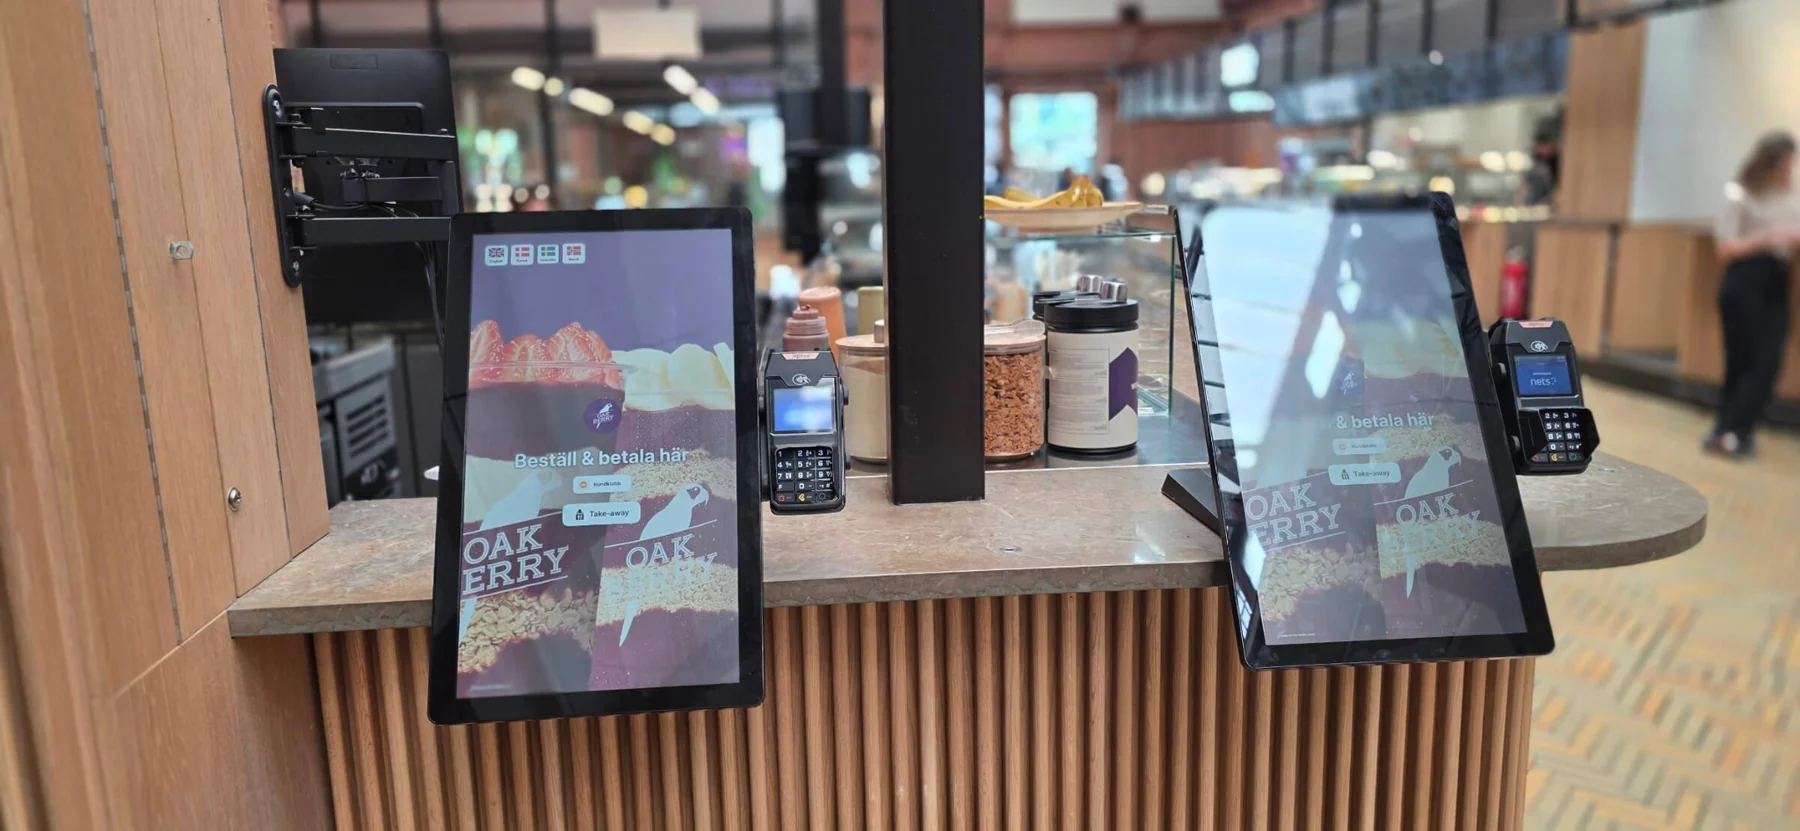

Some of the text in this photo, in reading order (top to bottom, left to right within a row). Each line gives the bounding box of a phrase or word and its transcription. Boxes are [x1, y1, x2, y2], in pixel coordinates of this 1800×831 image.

[1530, 378, 1551, 386] nets
[1336, 412, 1434, 429] & betala här
[515, 447, 688, 468] Beställ & betala här
[1246, 483, 1316, 520] OAK
[1396, 493, 1458, 525] OAK
[464, 524, 542, 564] OAK
[626, 534, 694, 570] OAK
[462, 545, 569, 595] ERRY
